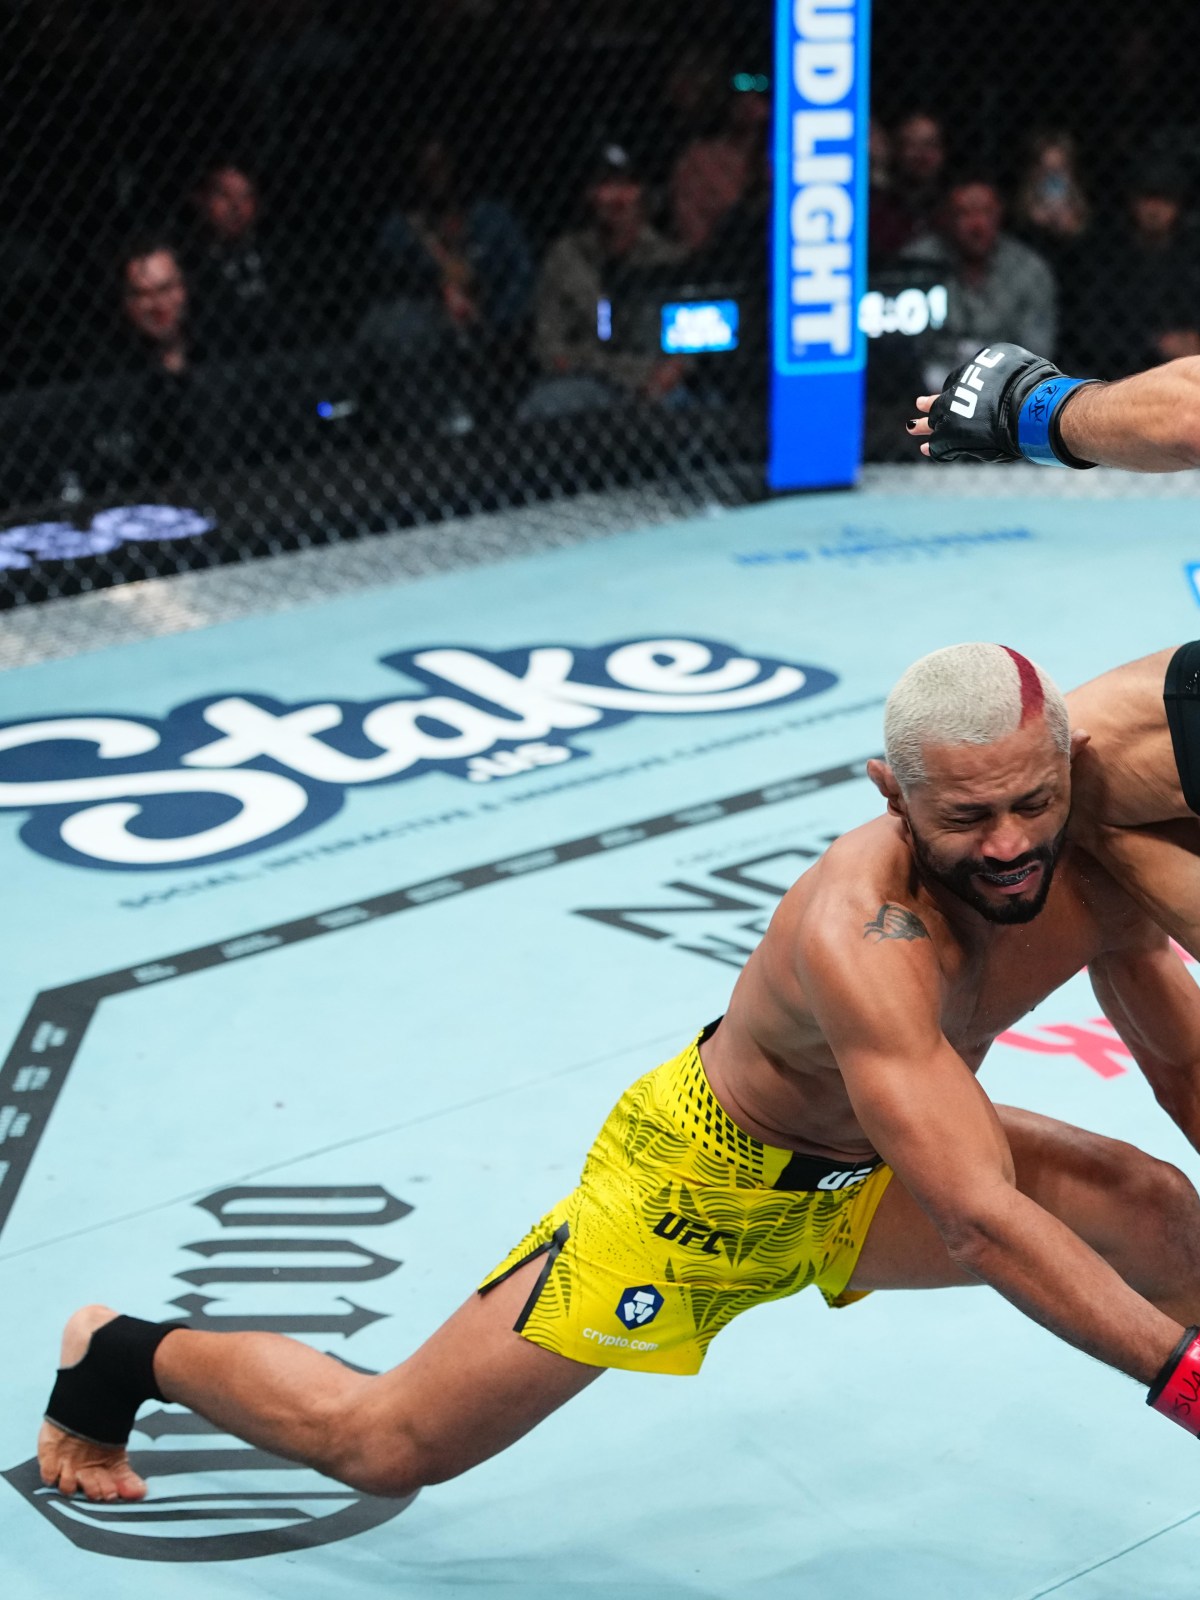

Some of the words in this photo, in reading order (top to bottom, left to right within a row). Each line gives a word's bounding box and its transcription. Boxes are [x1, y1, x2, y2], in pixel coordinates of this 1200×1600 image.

[789, 109, 854, 356] LIGHT
[950, 348, 1005, 419] UFC
[0, 638, 806, 863] Stake
[653, 1211, 736, 1256] UFC
[582, 1326, 660, 1353] crypto.com
